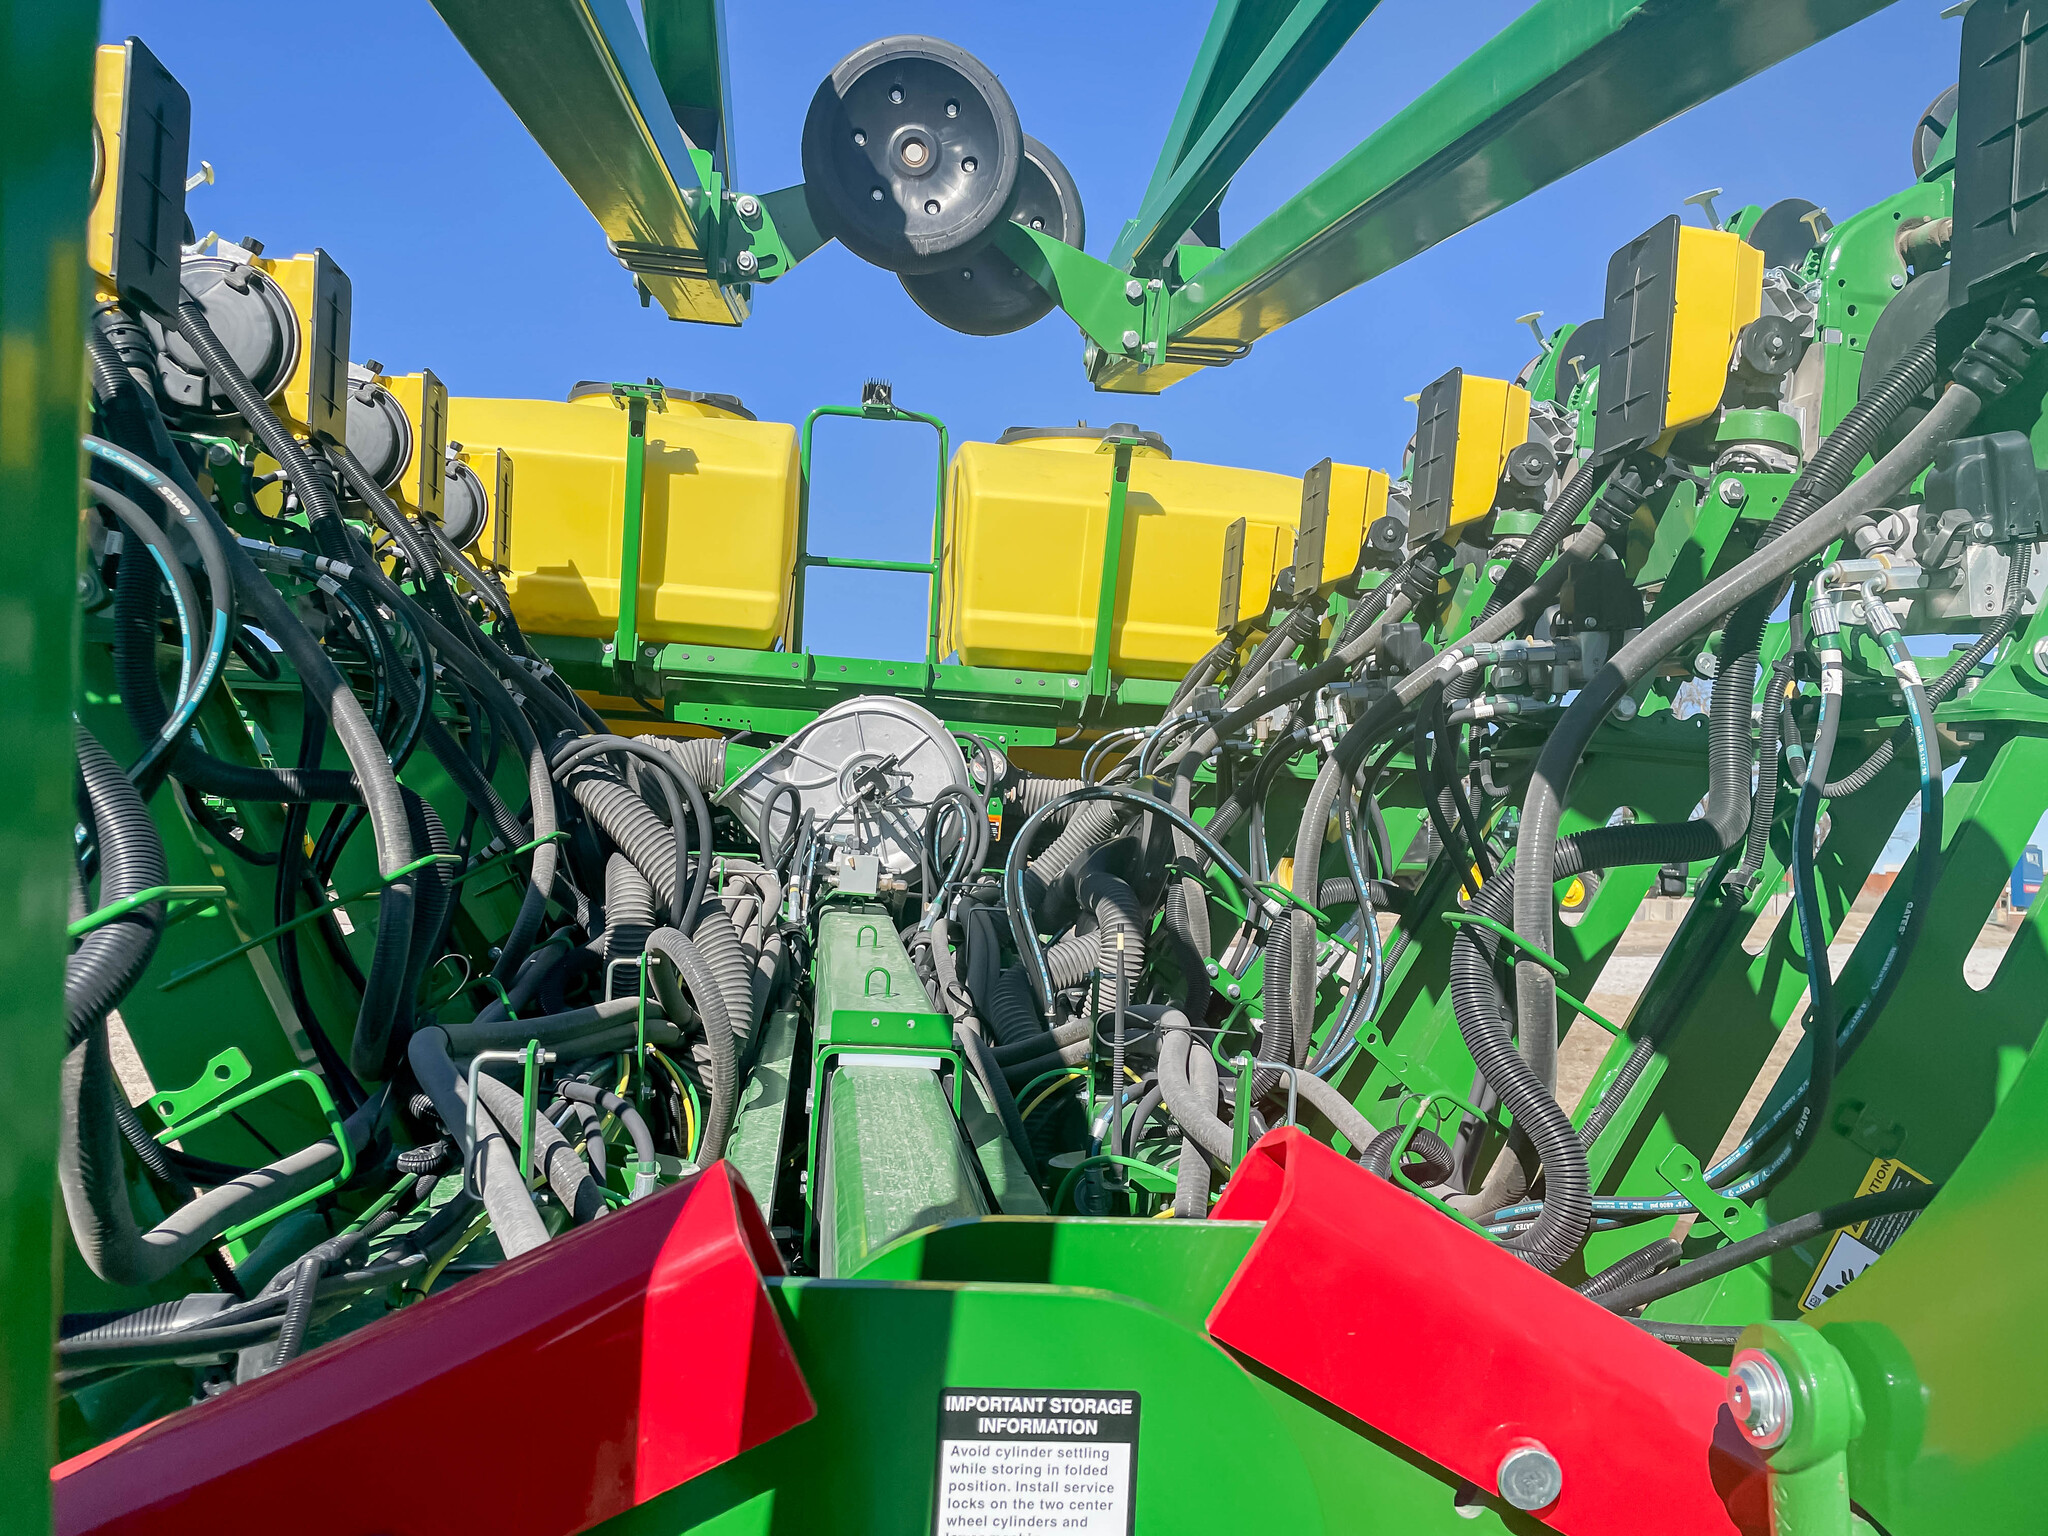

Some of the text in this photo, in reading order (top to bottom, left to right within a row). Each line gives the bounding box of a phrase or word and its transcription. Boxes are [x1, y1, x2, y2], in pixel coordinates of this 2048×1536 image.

[944, 1395, 1133, 1415] IMPORTANT STORAGE
[978, 1417, 1098, 1435] INFORMATION
[951, 1445, 1110, 1461] Avoid cylinder settling
[950, 1463, 1108, 1478] while storing in folded
[948, 1480, 1114, 1494] position. Install service
[947, 1498, 1114, 1511] locks on the two center
[946, 1515, 1088, 1530] wheel cylinders and
